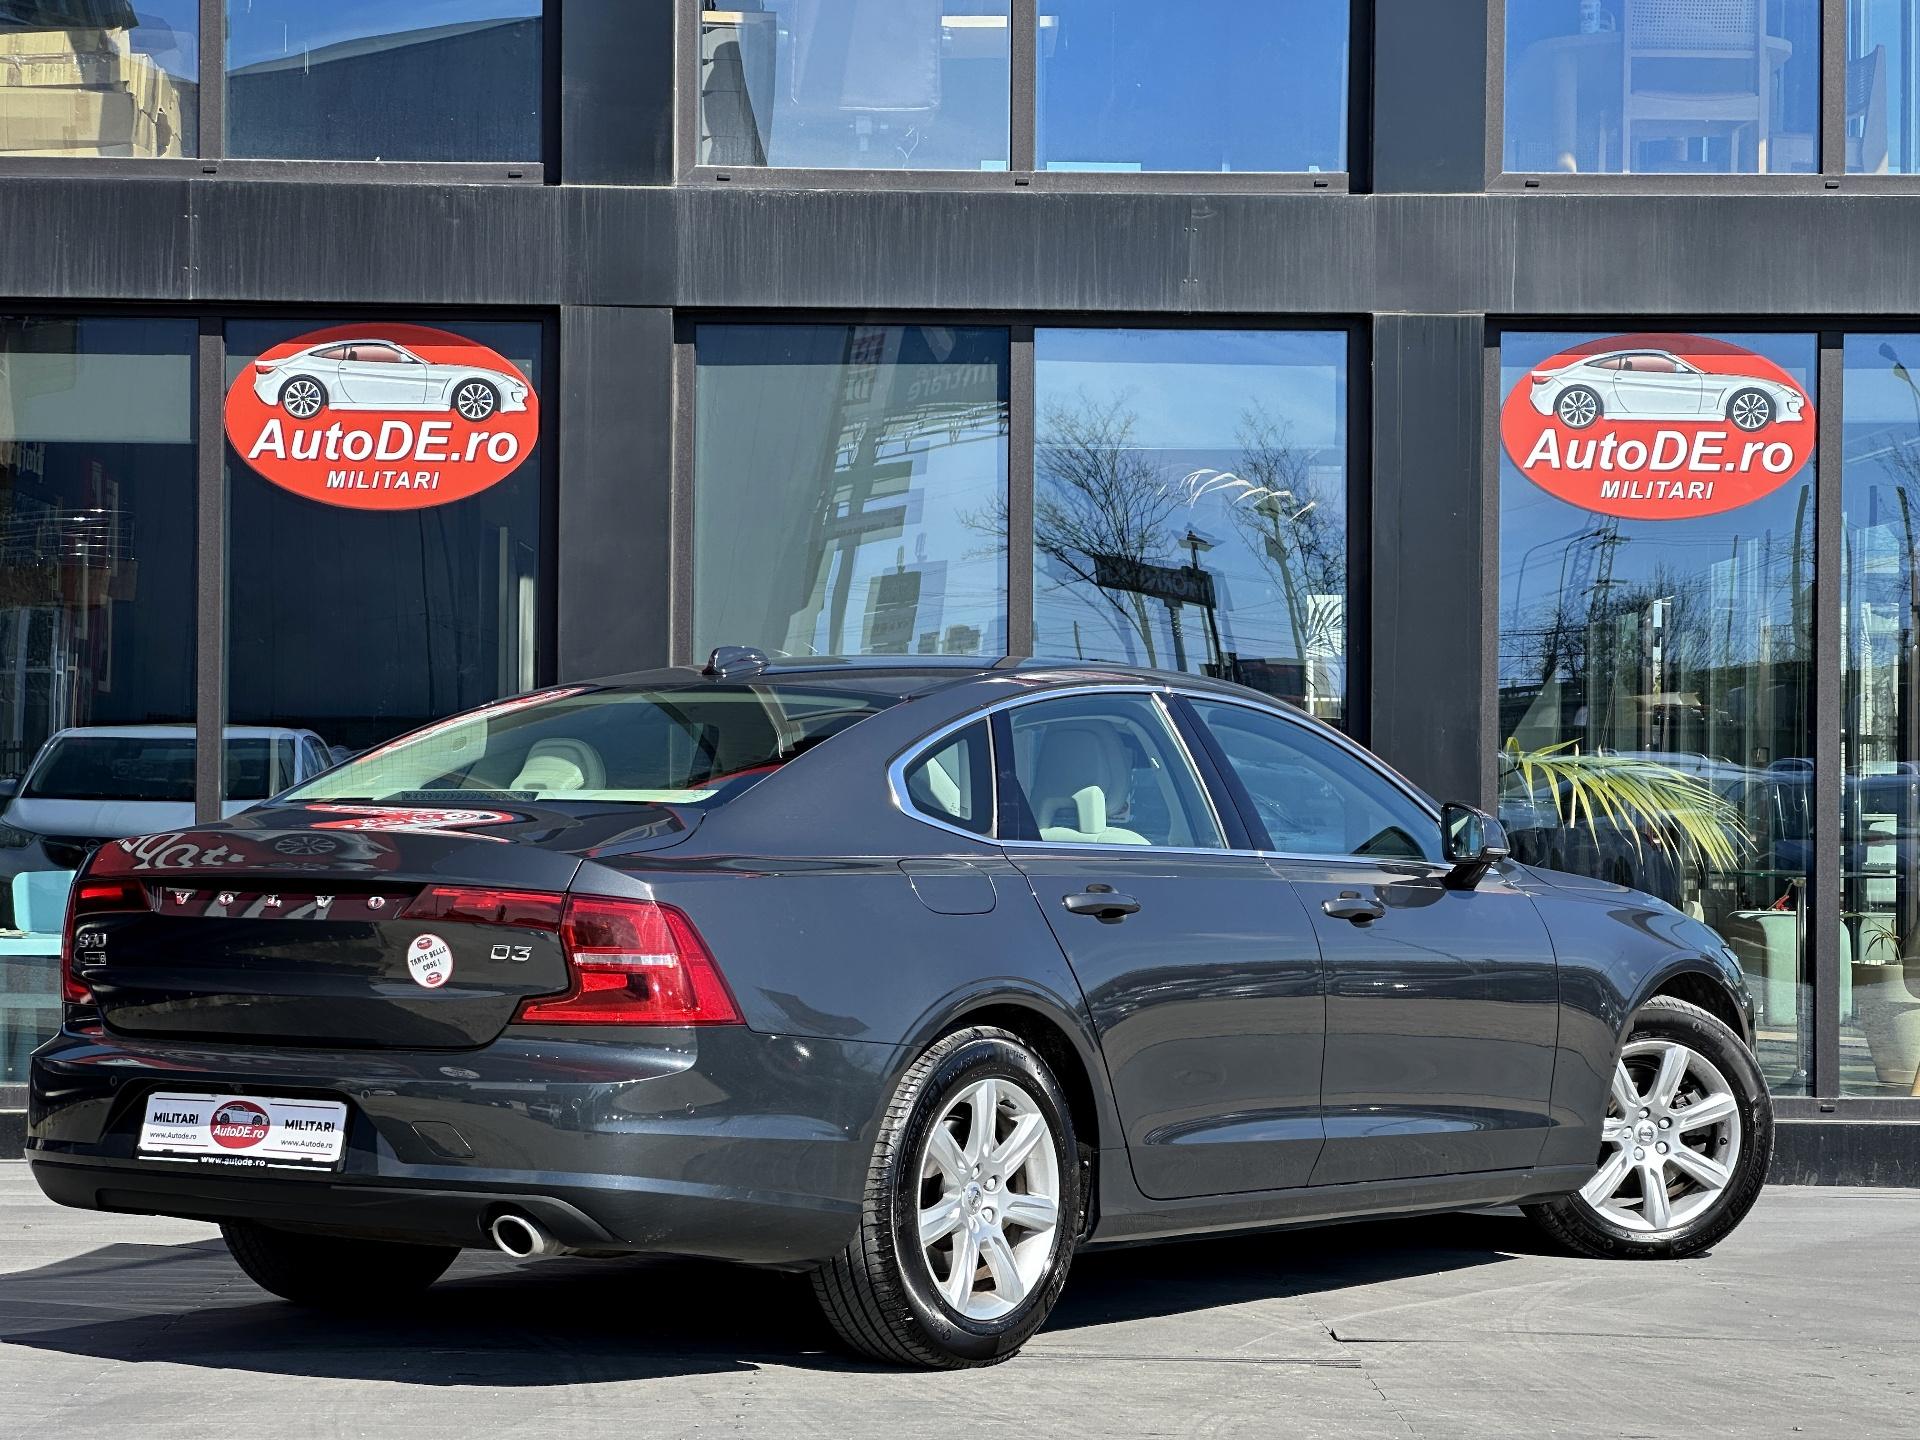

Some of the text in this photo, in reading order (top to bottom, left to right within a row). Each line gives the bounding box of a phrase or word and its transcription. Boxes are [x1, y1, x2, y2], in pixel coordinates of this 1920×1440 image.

[248, 419, 518, 463] AutoDE.ro
[1524, 429, 1795, 474] AutoDE.ro
[326, 471, 440, 490] MILITARI
[1600, 481, 1715, 501] MILITARI
[174, 891, 385, 909] VOLVO
[79, 933, 107, 948] S90
[410, 946, 447, 967] TANTE BELLE
[490, 944, 533, 962] D3
[423, 961, 437, 971] COSE
[153, 1112, 199, 1125] MILITARI
[285, 1120, 335, 1133] MILITARI
[150, 1131, 197, 1140] www.Autode.ro
[213, 1124, 265, 1140] AutoDE.ro
[281, 1139, 333, 1149] www.Autode.ro
[201, 1155, 266, 1167] www.autode.ro
